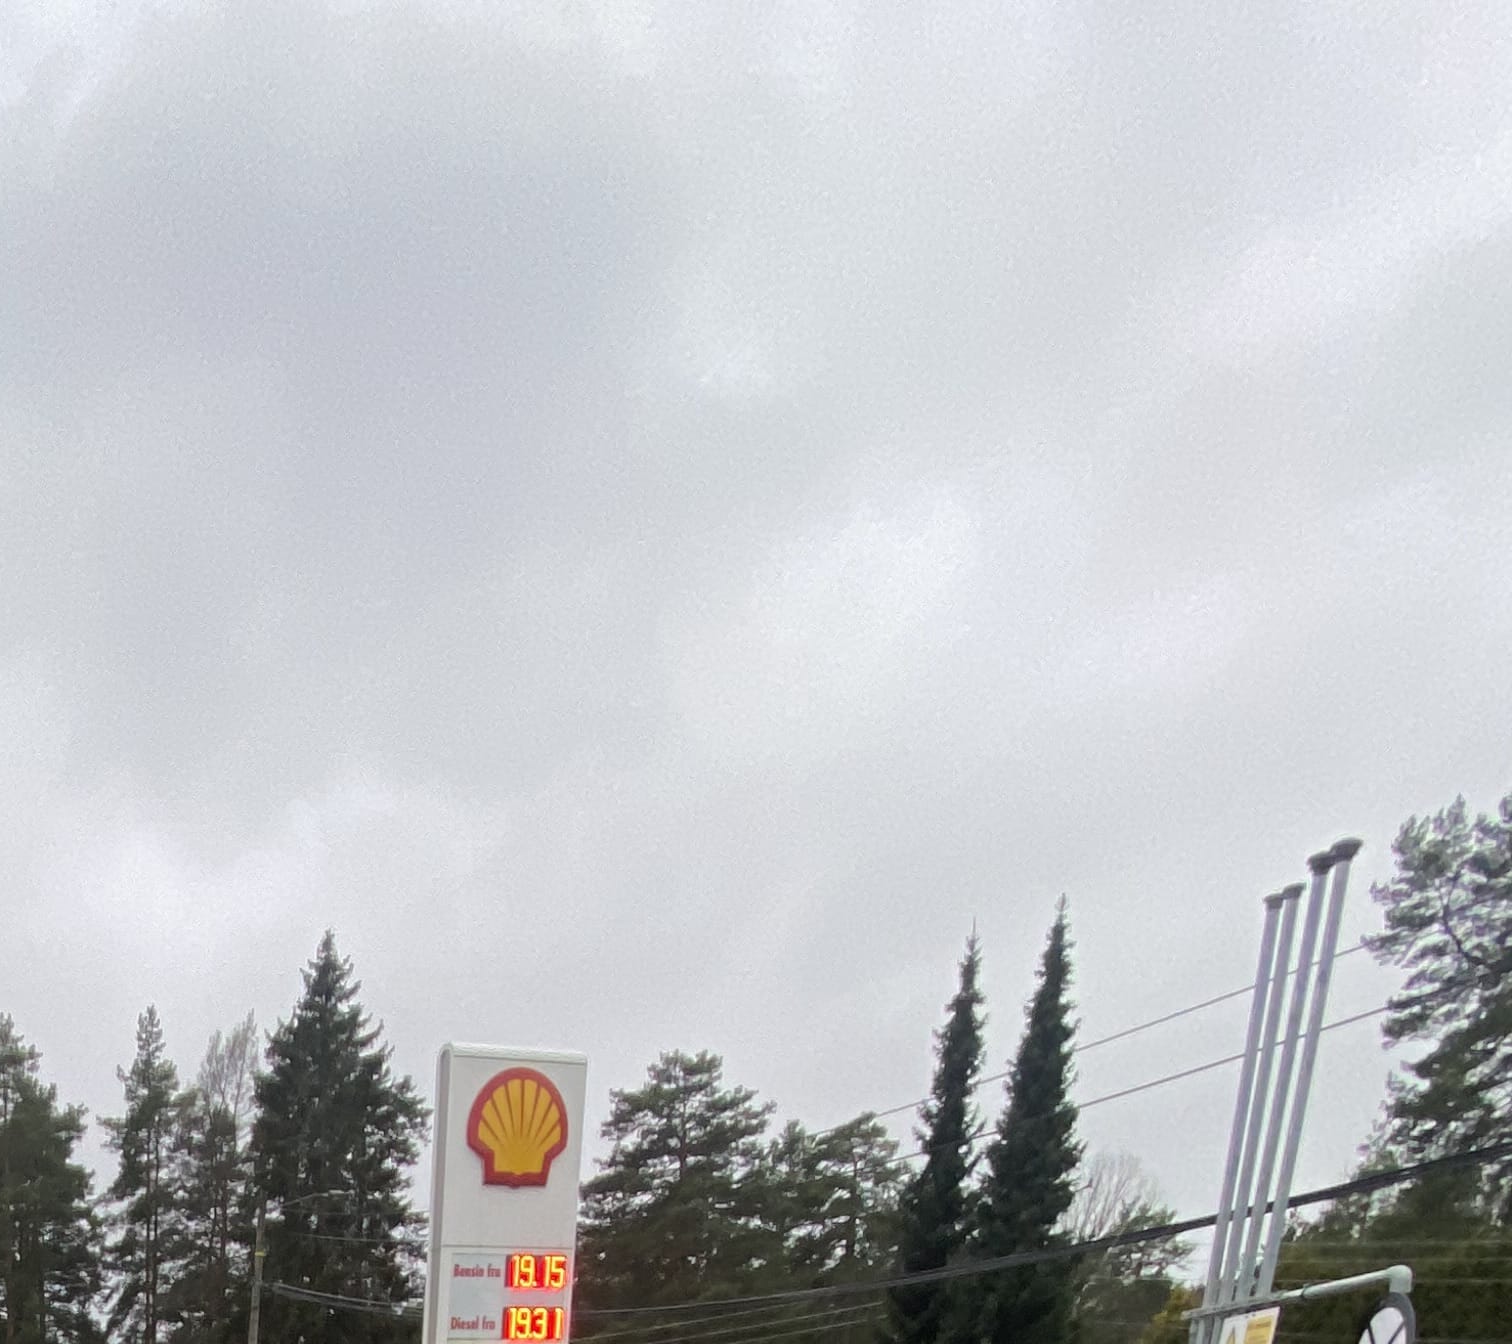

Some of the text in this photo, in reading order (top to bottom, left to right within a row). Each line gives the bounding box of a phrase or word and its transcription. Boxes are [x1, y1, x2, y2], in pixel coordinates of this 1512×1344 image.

[511, 1255, 567, 1288] 19.15
[450, 1315, 479, 1330] Diesel
[509, 1307, 564, 1339] 19.31
